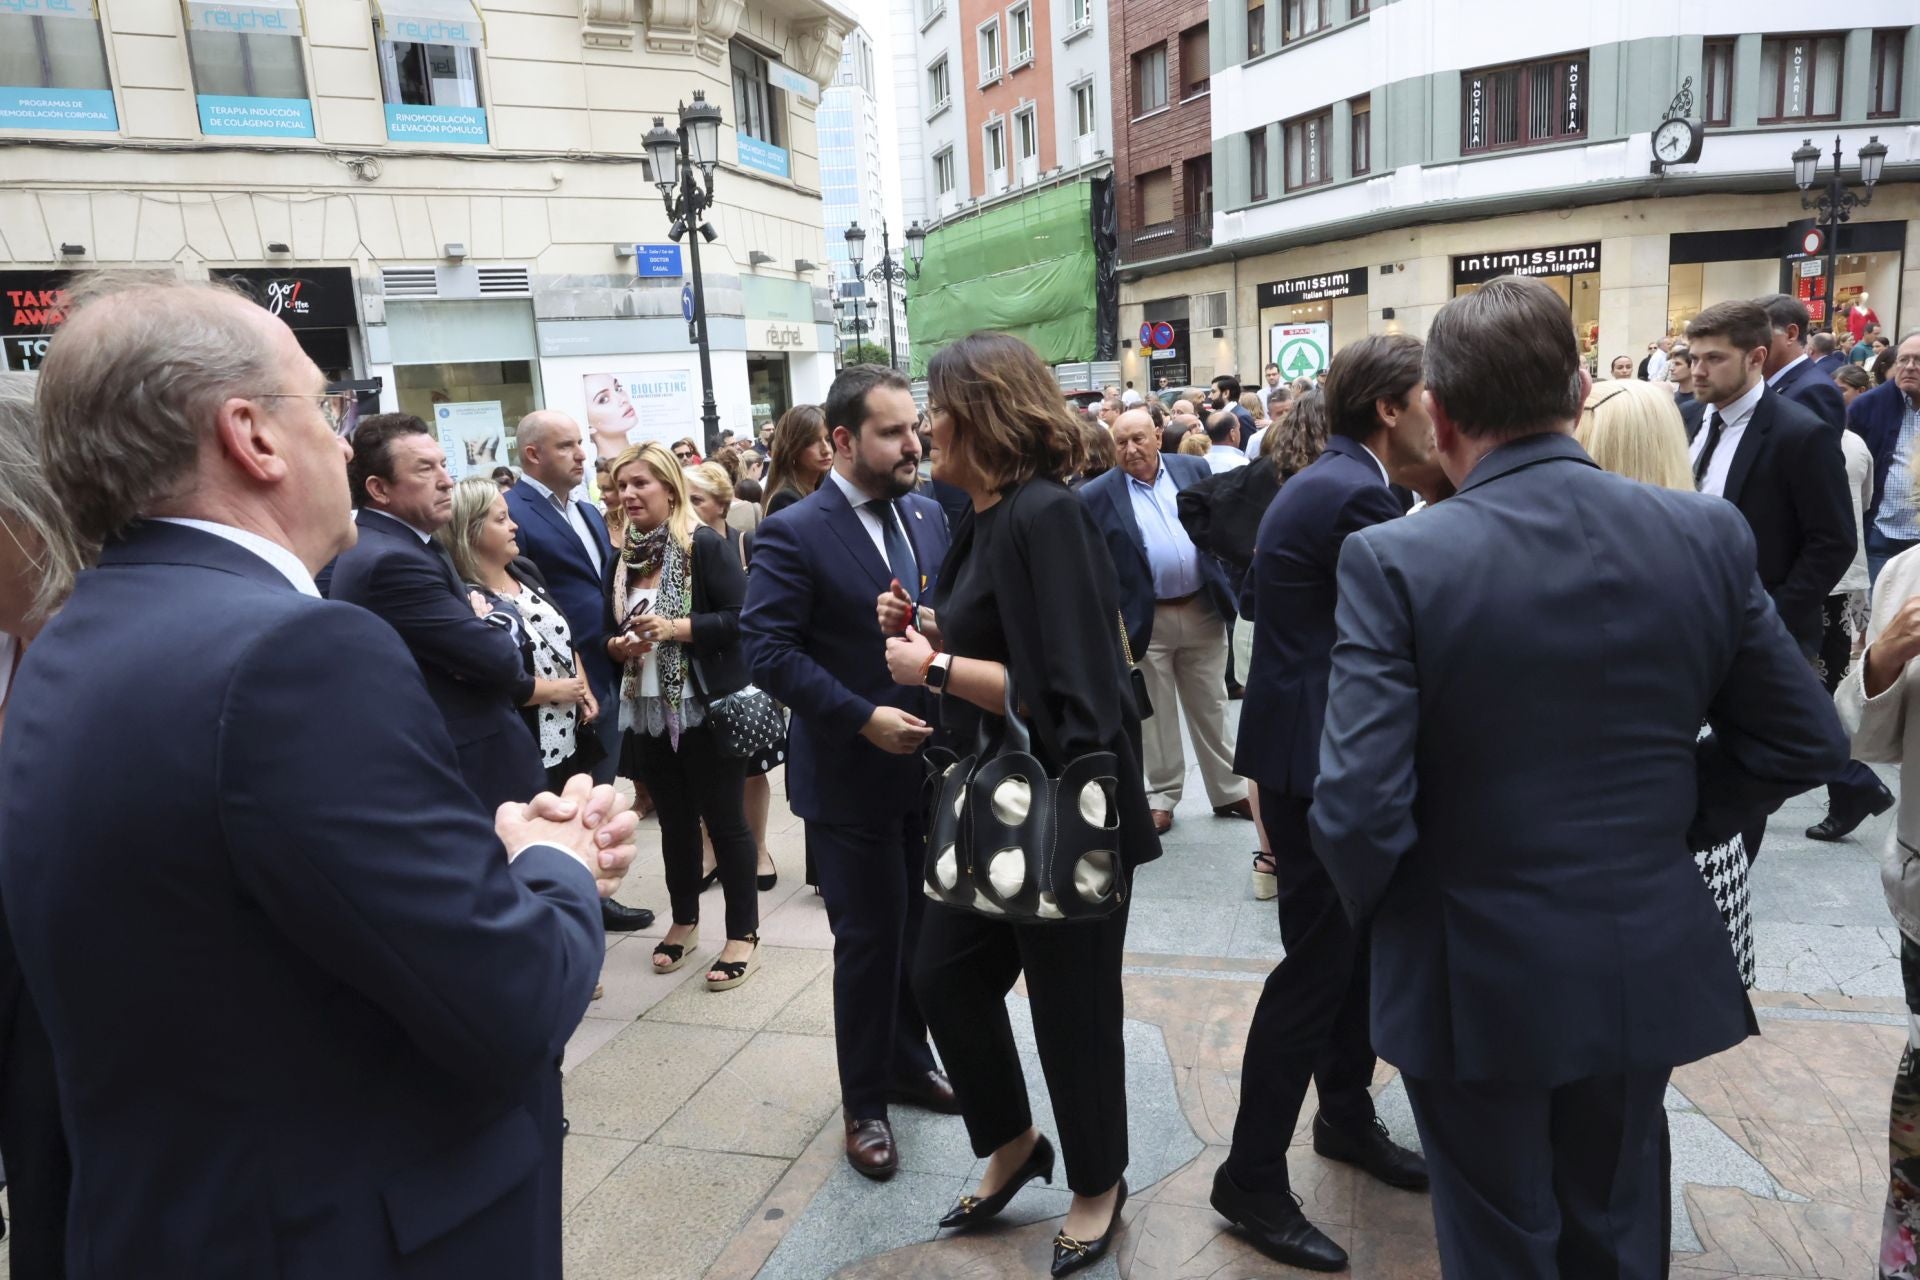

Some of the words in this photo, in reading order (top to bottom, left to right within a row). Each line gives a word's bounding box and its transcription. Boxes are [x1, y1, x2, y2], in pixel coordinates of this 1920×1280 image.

[1791, 46, 1802, 112] NOTARIA
[1568, 64, 1578, 129] NOTARIA
[19, 99, 71, 108] PROGRAMAS
[64, 111, 108, 119] CORPORAL
[209, 106, 248, 115] TERAPIA
[249, 107, 301, 117] INDUCCIÓN
[396, 112, 476, 124] RINOMODELACIÓN
[1472, 80, 1481, 143] NOTARIA
[210, 118, 222, 126] DE
[223, 117, 275, 128] COLÁGENO
[275, 120, 306, 129] FACIAL
[391, 122, 440, 133] ELEVACIÓN
[441, 123, 484, 134] PÓMULOS
[1460, 246, 1596, 272] intimissimi
[1551, 260, 1595, 273] lingerie
[1273, 273, 1349, 295] intimissimi
[1323, 286, 1349, 298] lingerie
[13, 308, 69, 326] AWA
[631, 381, 687, 394] BIOLIFTING
